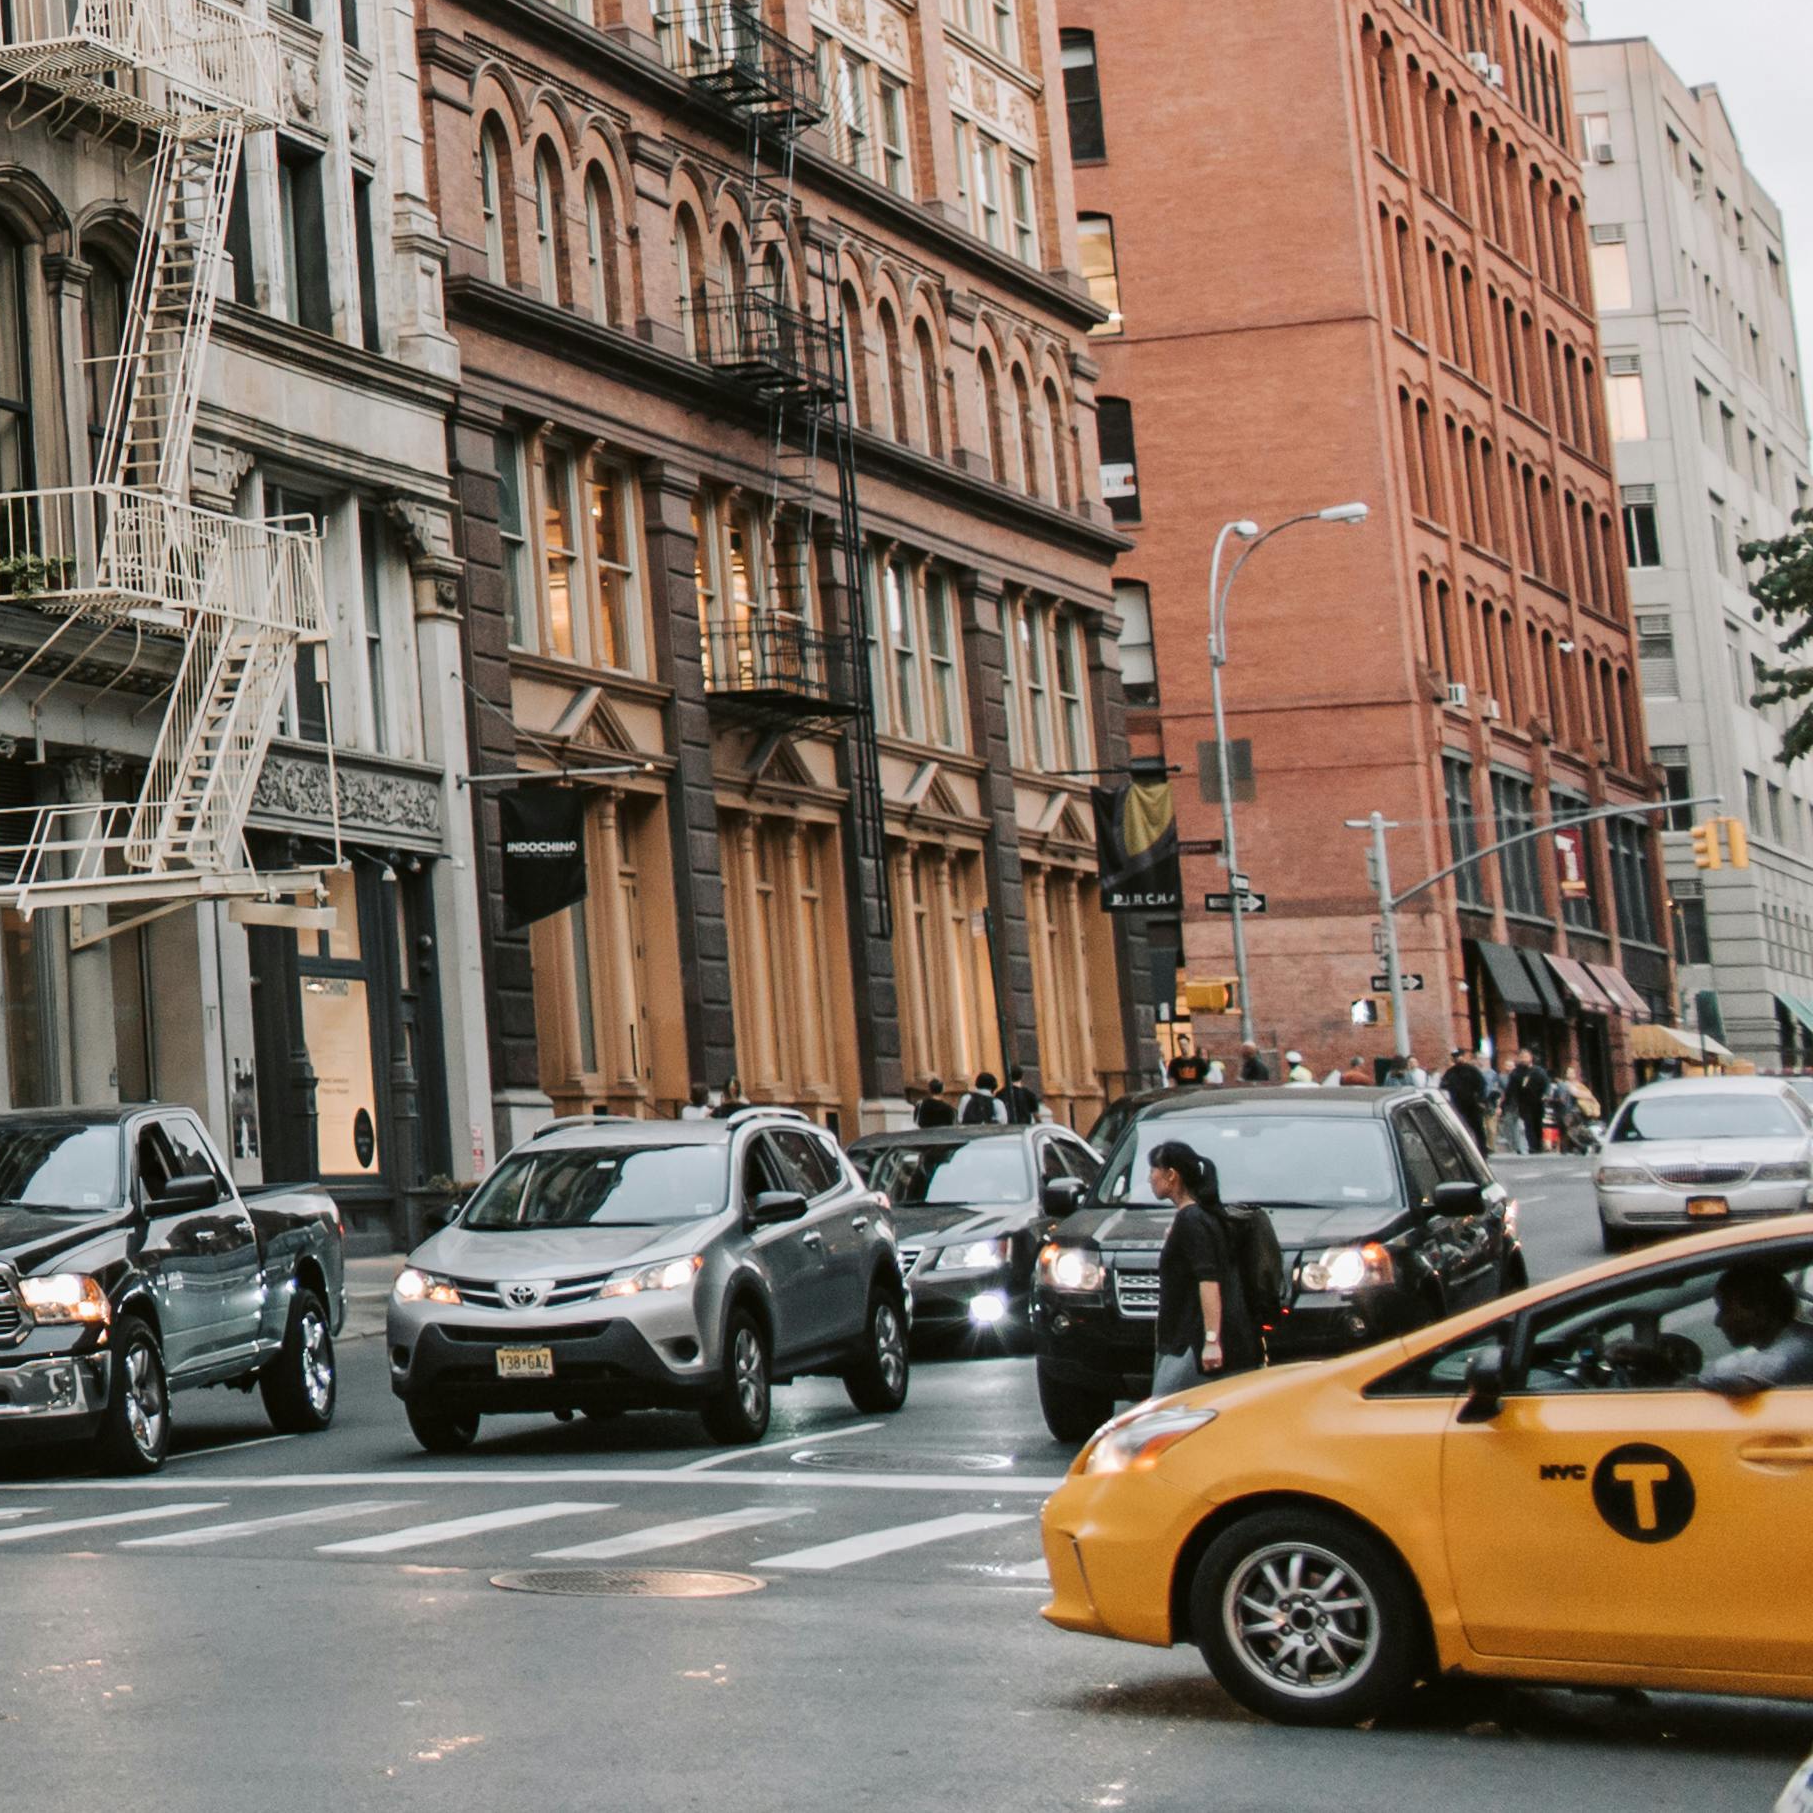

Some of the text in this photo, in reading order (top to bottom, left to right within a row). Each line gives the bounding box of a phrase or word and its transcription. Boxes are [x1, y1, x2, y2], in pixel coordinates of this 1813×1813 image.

[507, 840, 577, 853] INDOCHINO
[1539, 1462, 1670, 1530] NYC T
